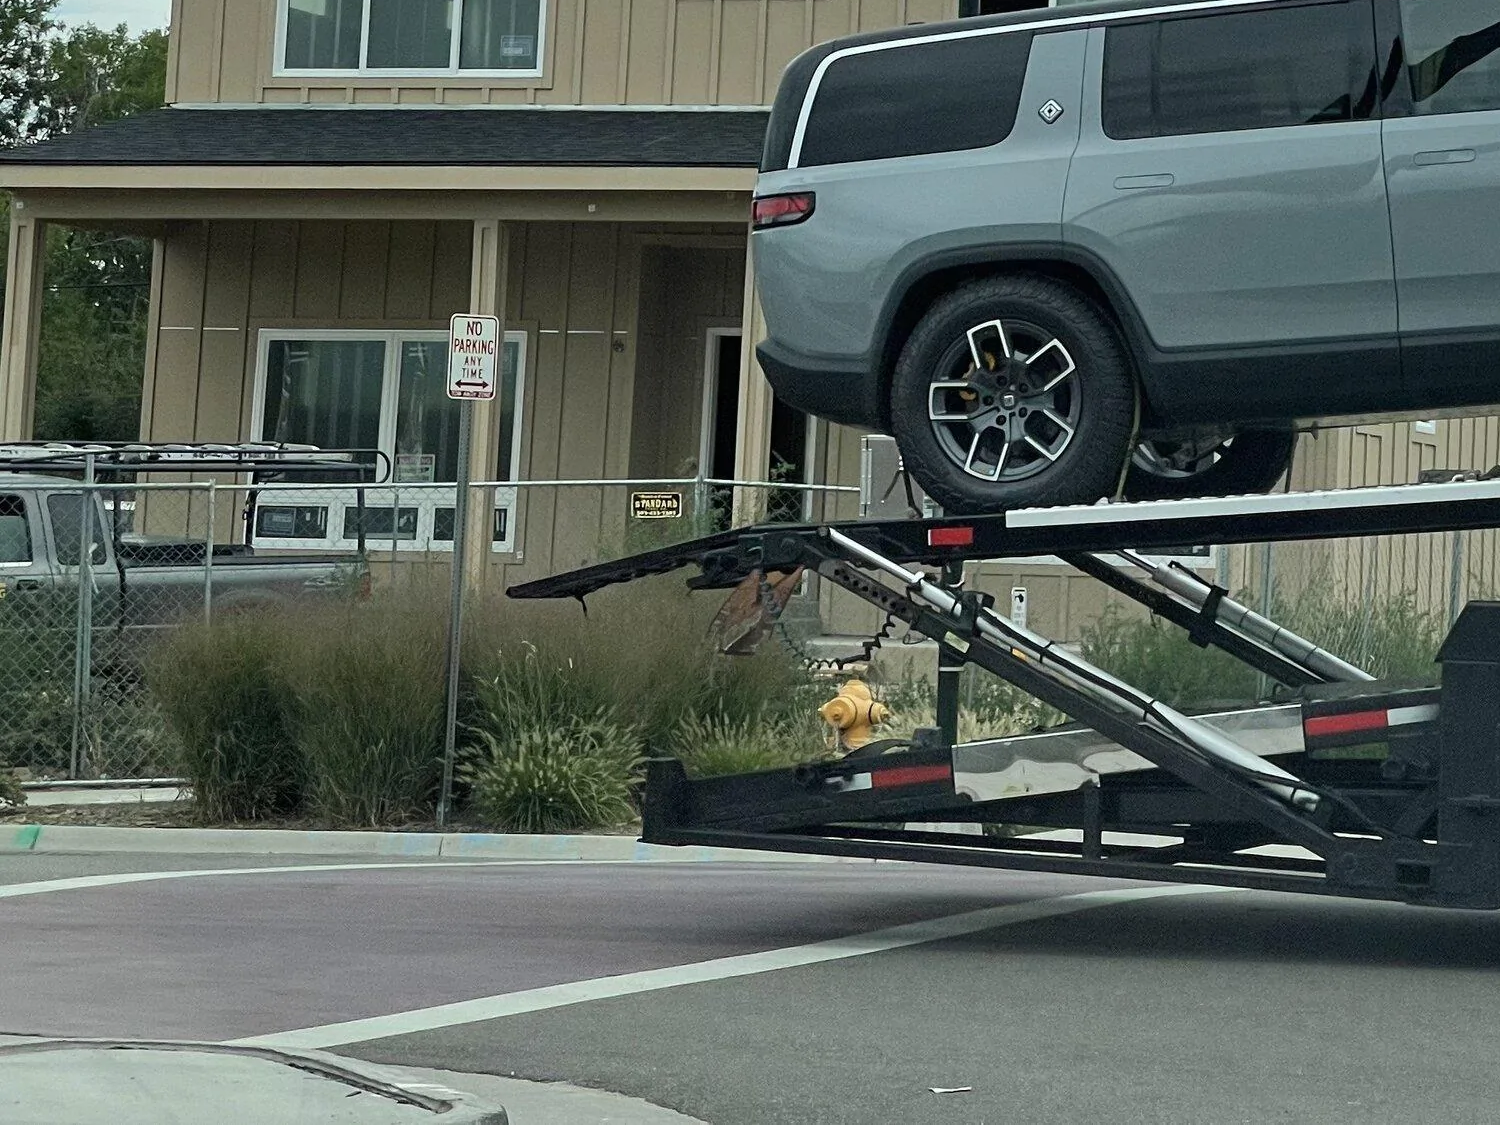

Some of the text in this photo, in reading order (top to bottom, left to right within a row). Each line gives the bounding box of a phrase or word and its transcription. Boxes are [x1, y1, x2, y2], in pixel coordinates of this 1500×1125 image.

[466, 321, 482, 335] NO
[453, 338, 493, 354] PARKING
[464, 356, 482, 366] ANY
[462, 368, 483, 379] TIME
[634, 498, 678, 509] STANDARD
